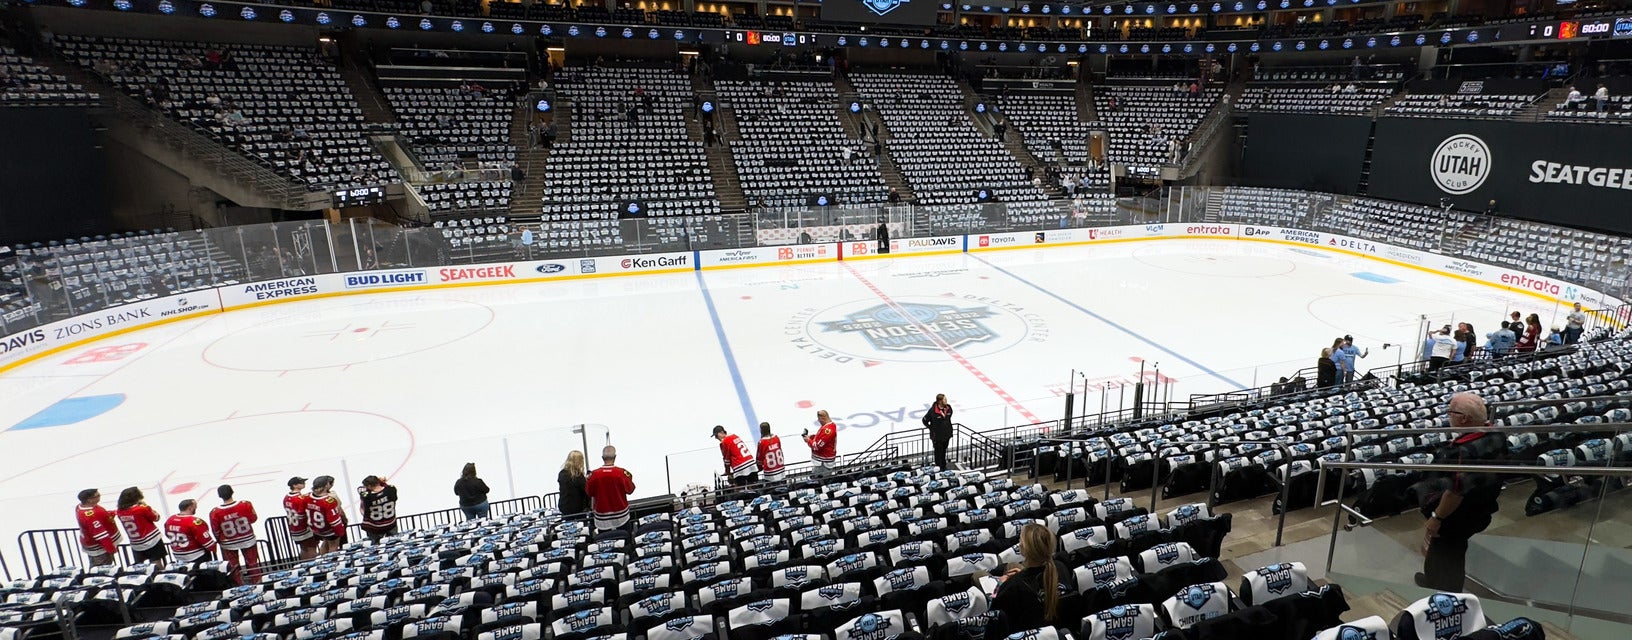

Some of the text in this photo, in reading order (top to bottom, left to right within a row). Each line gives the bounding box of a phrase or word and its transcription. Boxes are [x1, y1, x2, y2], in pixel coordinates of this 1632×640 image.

[1544, 26, 1552, 36] 0
[1582, 23, 1609, 33] 60:00
[737, 33, 743, 41] 0
[800, 35, 805, 43] 0
[1447, 141, 1480, 154] HOCKEY
[1440, 155, 1481, 177] UTAH
[1446, 179, 1468, 188] CLUB
[1186, 226, 1230, 235] entrata
[1280, 229, 1320, 239] AMERICAN
[991, 236, 1016, 244] TOYOTA
[1285, 235, 1319, 245] EXPRESS
[1340, 239, 1376, 253] DELTA
[632, 255, 687, 268] Ken Garff
[440, 264, 515, 282] SEATGEEK
[347, 272, 424, 286] BUD LIGHT
[1501, 273, 1560, 295] entrata
[245, 277, 315, 293] AMERICAN
[256, 285, 318, 300] EXPRESS
[54, 307, 151, 340] ZIONS BANK
[738, 442, 751, 459] 2
[370, 501, 396, 520] 88
[93, 520, 101, 529] 2
[305, 509, 325, 529] 19
[221, 517, 251, 538] 88
[921, 522, 937, 530] GAME
[1129, 523, 1147, 534] GAME
[959, 534, 979, 544] GAME
[816, 545, 833, 553] GAME
[902, 543, 920, 551] GAME
[1156, 545, 1177, 555] GAME
[759, 552, 777, 560] GAME
[640, 561, 660, 571] GAME
[696, 566, 715, 577] GAME
[843, 560, 863, 572] GAME
[1092, 563, 1115, 576] GAME
[582, 572, 600, 581] GAME
[635, 576, 655, 586] GAME
[892, 572, 914, 584] GAME
[1266, 570, 1290, 583] GAME
[520, 583, 541, 593] GAME
[715, 583, 737, 595] GAME
[325, 592, 344, 601] GAME
[568, 593, 590, 603] GAME
[942, 592, 968, 603] GAME
[387, 605, 410, 616] GAME
[498, 606, 521, 616] GAME
[647, 599, 670, 612] GAME
[313, 620, 335, 634] GAME
[420, 621, 443, 631] GAME
[571, 616, 597, 629] GAME
[1107, 618, 1133, 630] GAME
[1436, 615, 1461, 631] GAME
[495, 625, 522, 638] GAME
[858, 628, 885, 640] GAME
